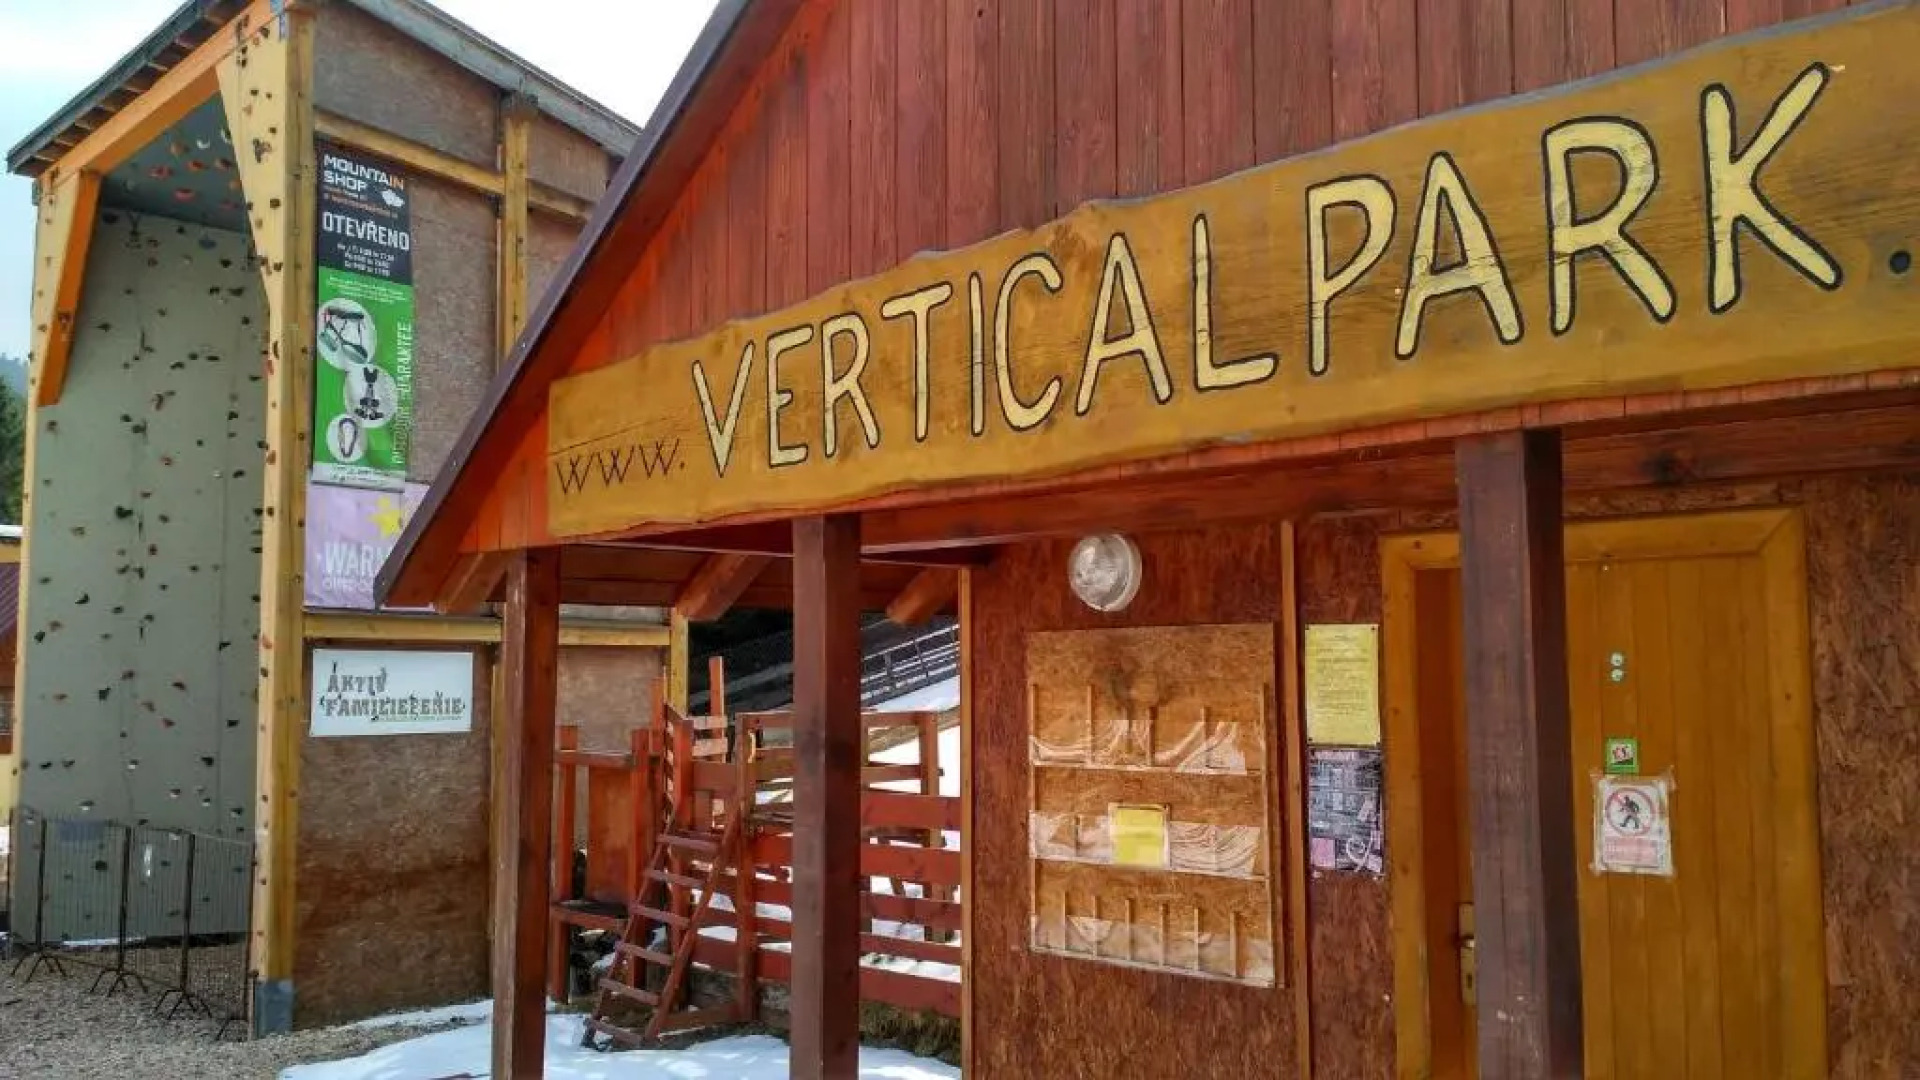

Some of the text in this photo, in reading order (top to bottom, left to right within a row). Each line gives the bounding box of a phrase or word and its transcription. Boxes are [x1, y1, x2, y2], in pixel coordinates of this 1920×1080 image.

[323, 153, 404, 191] MOUNTAIN
[323, 170, 368, 192] SHOP
[322, 211, 410, 251] OTEVŘENO
